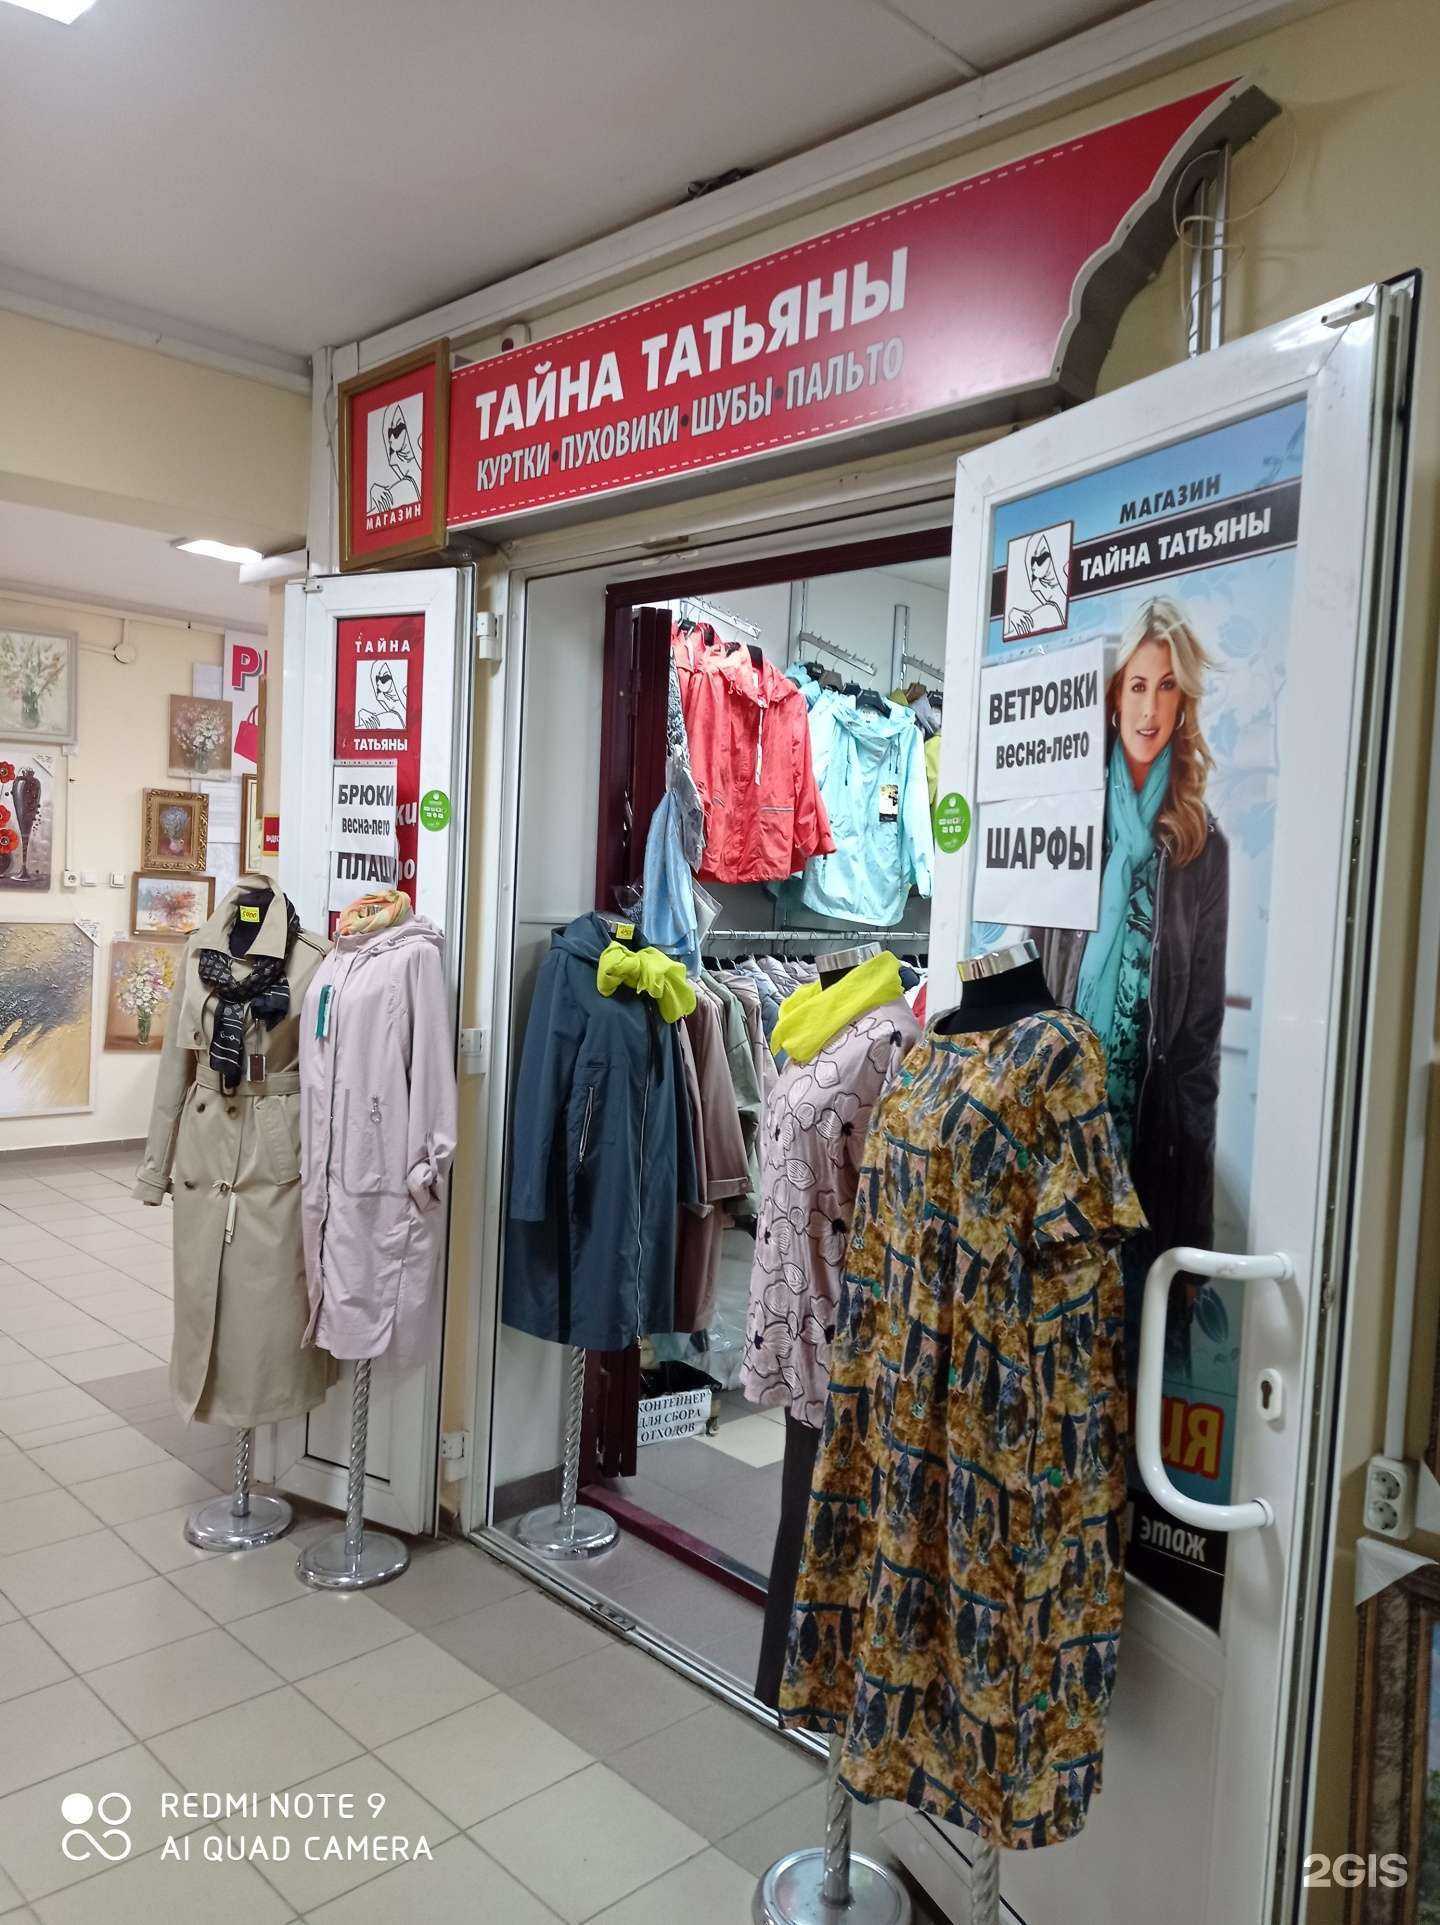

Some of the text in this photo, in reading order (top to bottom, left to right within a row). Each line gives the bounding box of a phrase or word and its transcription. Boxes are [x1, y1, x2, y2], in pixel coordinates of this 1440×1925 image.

[475, 246, 909, 440] ТАЙНА ТАТЬЯНЫ
[476, 336, 905, 491] КУРТКИ ПУХОВИКИ ШУБЫ ПАЛЬТО
[366, 503, 422, 531] МАГАЗИН
[1118, 473, 1222, 524] МАГАЗИН
[1080, 507, 1272, 581] ТАЙНА ТАТЬЯНЫ
[355, 638, 411, 653] ТАЙНА
[988, 669, 1099, 727] ВЕТРОВКИ
[353, 738, 408, 751] ТАТЬЯНЫ
[995, 729, 1090, 770] весна-лето
[337, 784, 395, 806] БРЮКИ
[985, 823, 1095, 874] ШАРФЫ
[640, 1422, 696, 1442] ОТХОДОВ
[664, 1408, 701, 1423] СБОРА
[1139, 1514, 1208, 1563] этаж
